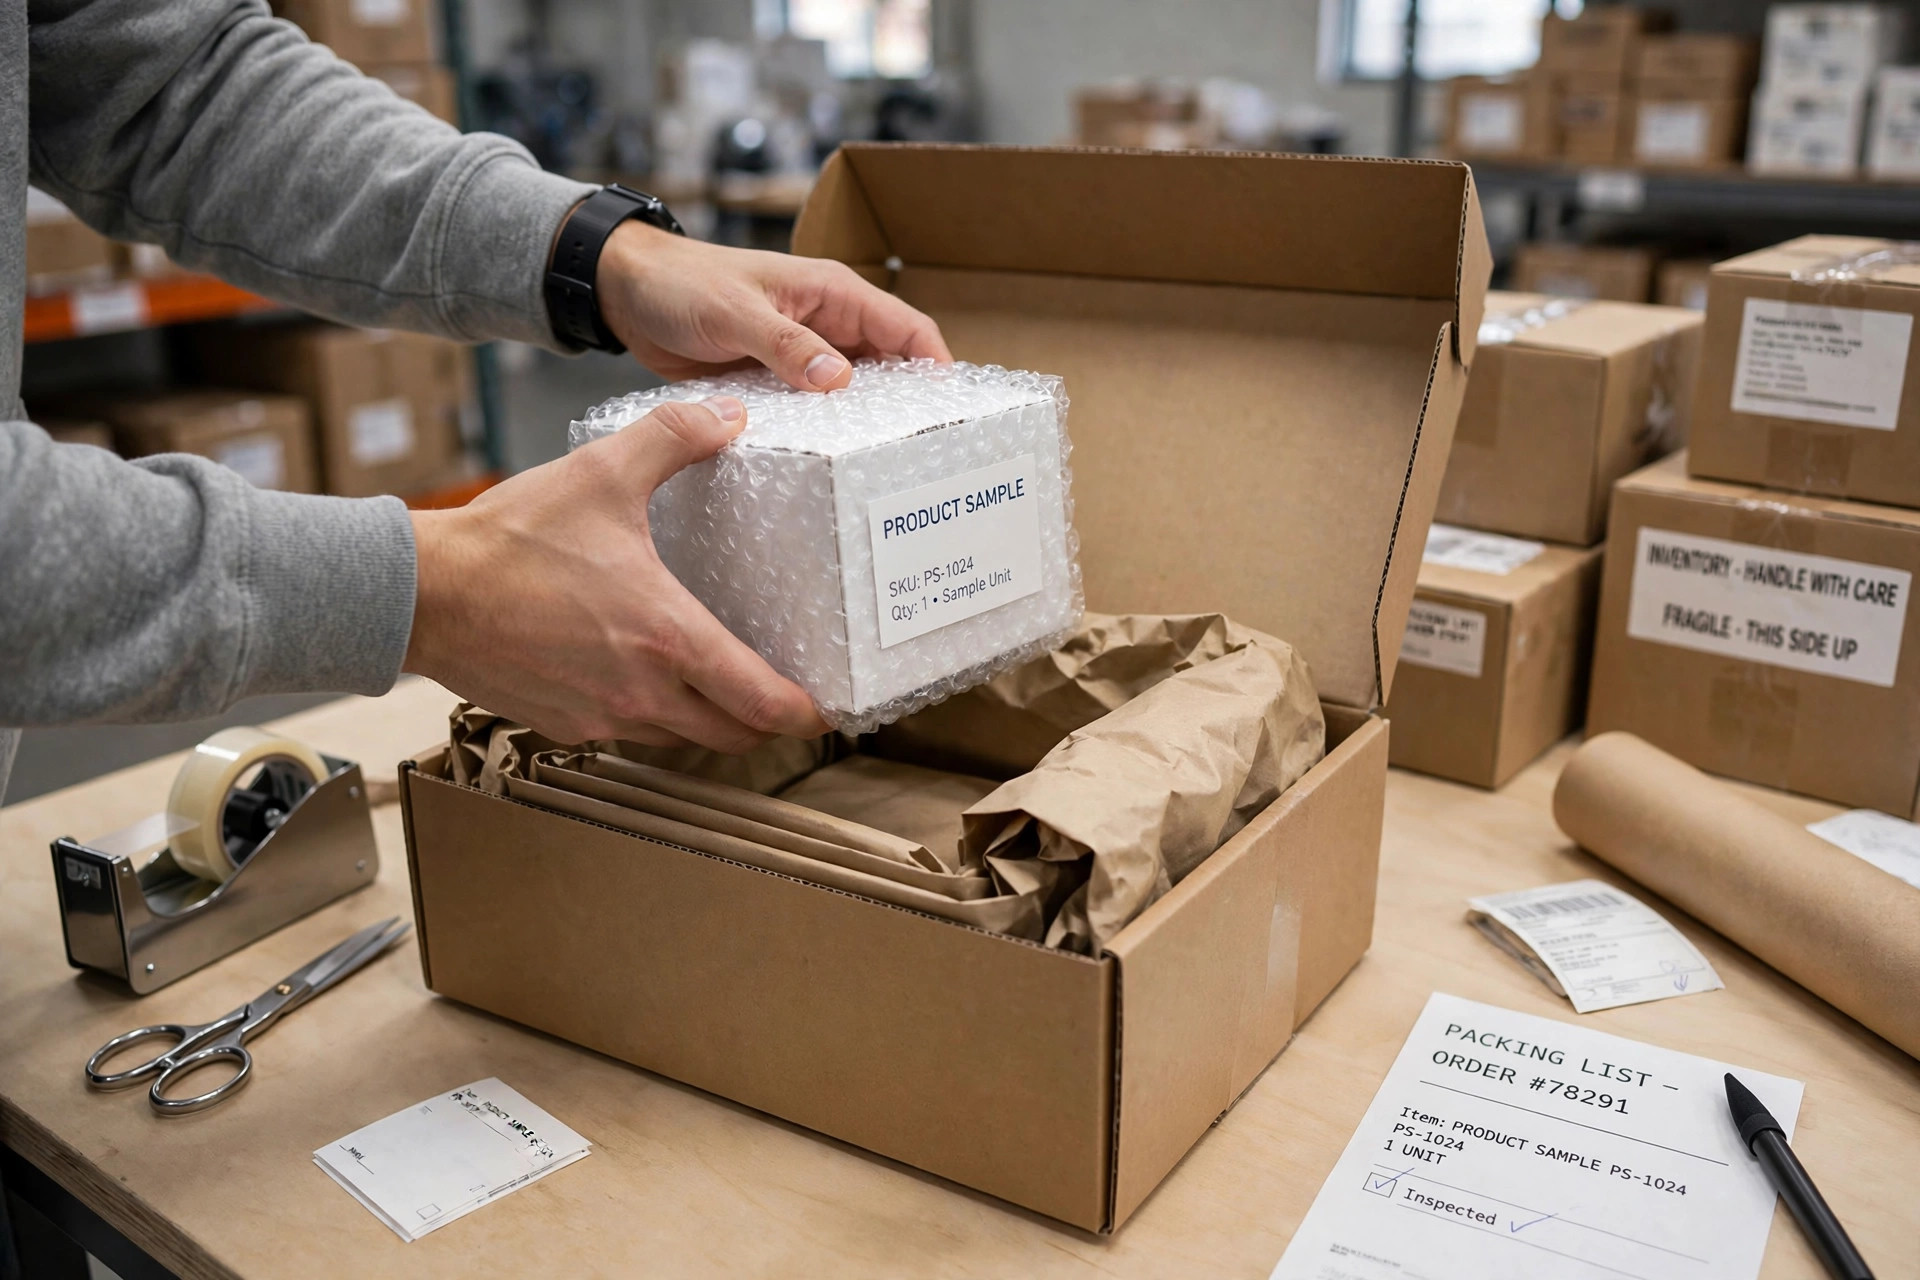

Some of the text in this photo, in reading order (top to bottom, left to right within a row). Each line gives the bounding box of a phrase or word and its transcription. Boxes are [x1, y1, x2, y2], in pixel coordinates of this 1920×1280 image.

[883, 478, 1025, 539] PRODUCT SAMPLE
[889, 557, 974, 598] SKU: PS-1024
[891, 602, 918, 621] Qty:
[922, 596, 928, 611] 1
[942, 577, 986, 604] Sample
[989, 568, 1012, 588] Unit
[1647, 543, 1732, 578] INVENTORY
[1744, 560, 1807, 591] HANDLE
[1810, 571, 1850, 597] WITH
[1854, 579, 1898, 607] CARE
[1662, 604, 1731, 638] FRAGILE
[1747, 620, 1784, 648] THIS
[1789, 629, 1828, 657] SIDE
[1832, 638, 1858, 661] UP
[1432, 1051, 1630, 1115] ORDER #78291
[1445, 1023, 1565, 1066] PACKING
[1581, 1058, 1652, 1089] LIST
[1383, 1139, 1447, 1165] 1 UNIT
[1392, 1123, 1465, 1152] PS-1024
[1399, 1107, 1687, 1196] Item: PRODUCT SAMPLE PS-1024
[1404, 1188, 1497, 1226] Inspected
